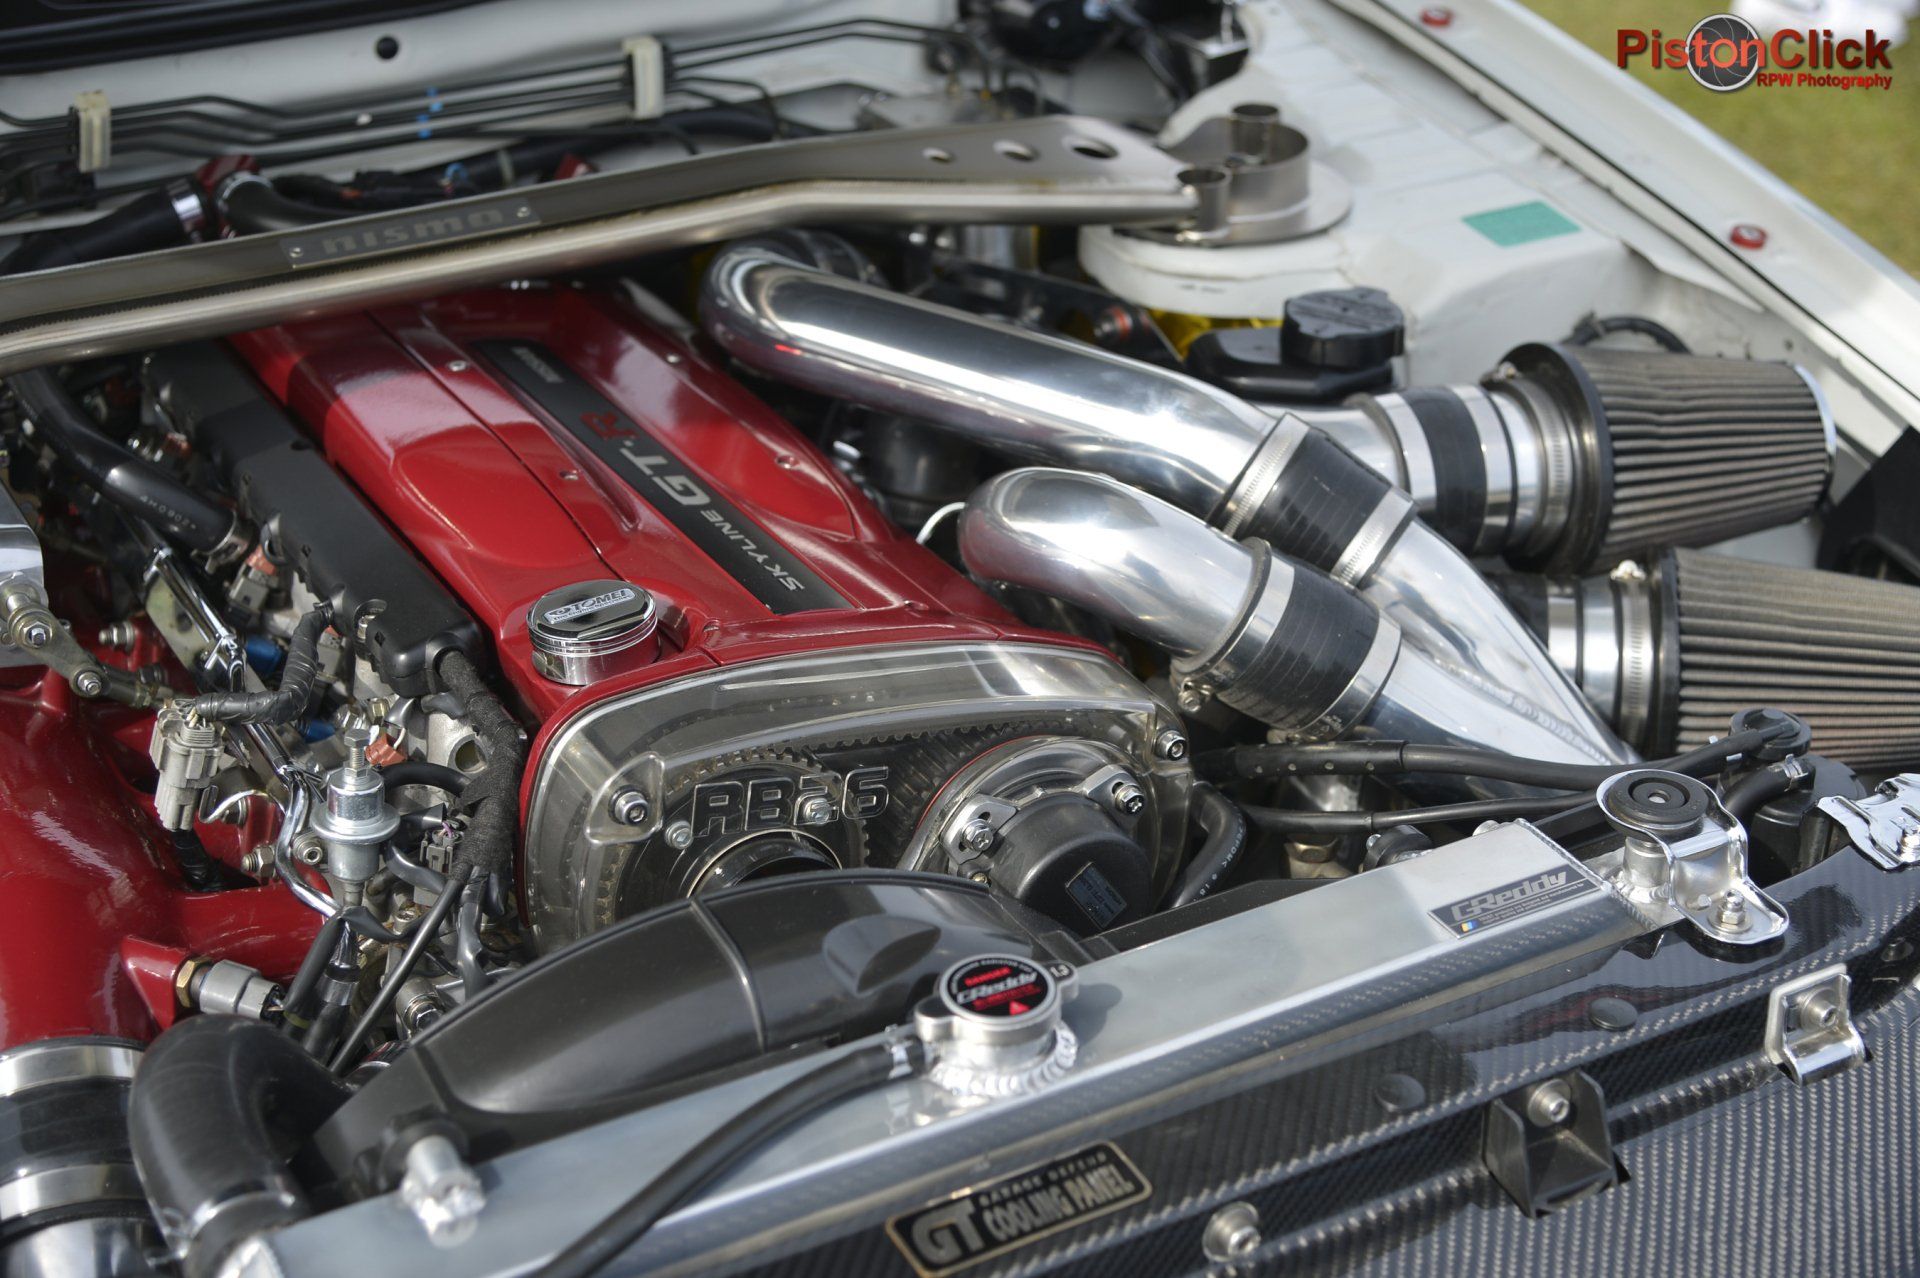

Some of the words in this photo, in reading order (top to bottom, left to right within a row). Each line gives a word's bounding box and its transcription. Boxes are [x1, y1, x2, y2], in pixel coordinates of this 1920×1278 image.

[323, 210, 503, 254] nismo
[701, 509, 805, 592] SKYLINE
[691, 766, 889, 838] RB26
[1452, 871, 1567, 921] GReddy
[911, 1200, 985, 1263] GT
[983, 1185, 1075, 1241] COOLING
[1064, 1164, 1135, 1212] PANEL
